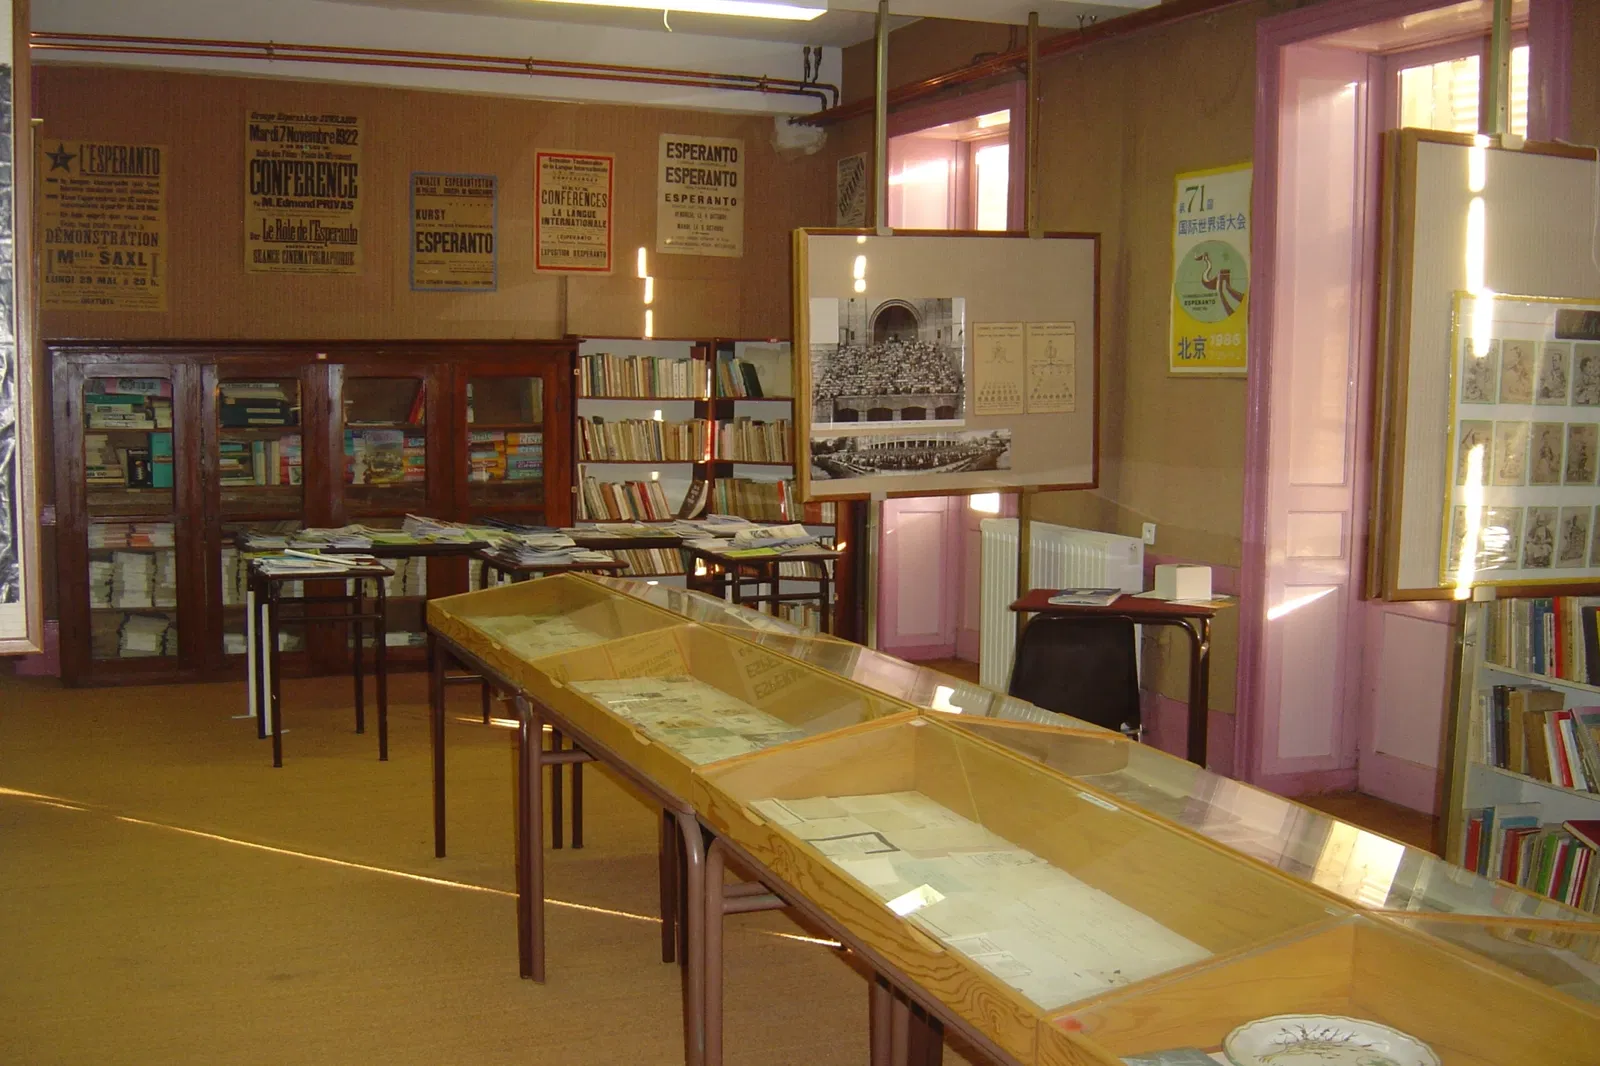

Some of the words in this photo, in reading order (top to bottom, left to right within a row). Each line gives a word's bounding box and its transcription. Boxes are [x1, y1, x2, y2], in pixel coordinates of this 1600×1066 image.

[249, 124, 279, 142] Mardi
[279, 125, 286, 142] 7
[286, 126, 336, 144] Novembre
[335, 127, 359, 146] 1922
[79, 143, 160, 175] L'ESPERANTO
[666, 141, 738, 163] ESPERANTO
[665, 166, 737, 188] ESPERANTO
[275, 197, 315, 208] Edmond
[664, 193, 737, 207] ESPERANTO
[415, 208, 446, 221] KURSY
[552, 207, 562, 217] LA
[566, 209, 597, 219] LANGUE
[262, 218, 274, 241] Le
[296, 218, 308, 241] de
[541, 217, 607, 229] INTERNATIONALE
[1178, 212, 1246, 236] 国际世界语大会
[415, 231, 494, 254] ESPERANTO
[98, 250, 148, 267] SAXL
[45, 275, 75, 284] LUNDI
[97, 277, 117, 285] MAI
[1183, 299, 1216, 307] ESPERANTO
[1178, 335, 1207, 360] 北京
